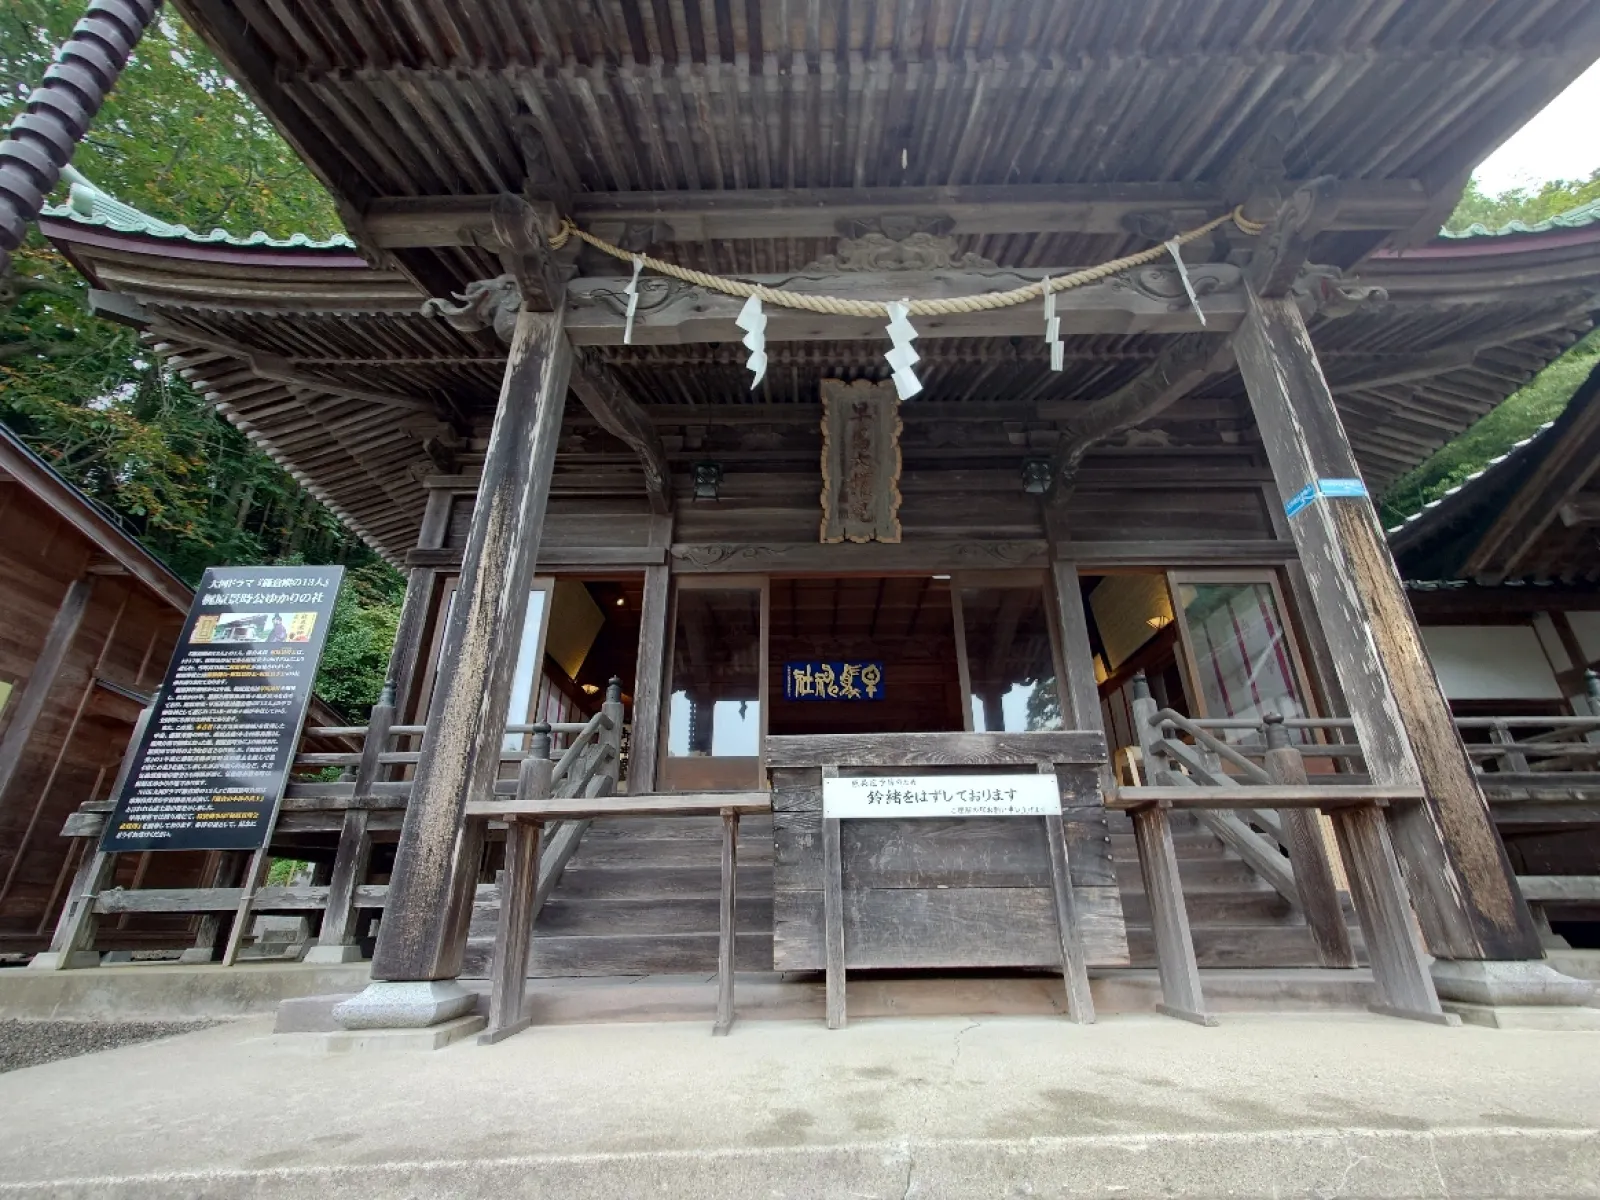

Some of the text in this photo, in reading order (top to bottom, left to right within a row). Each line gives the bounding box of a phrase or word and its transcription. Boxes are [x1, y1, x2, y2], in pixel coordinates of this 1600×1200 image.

[866, 788, 1018, 805] 鈴緒をはずしております
